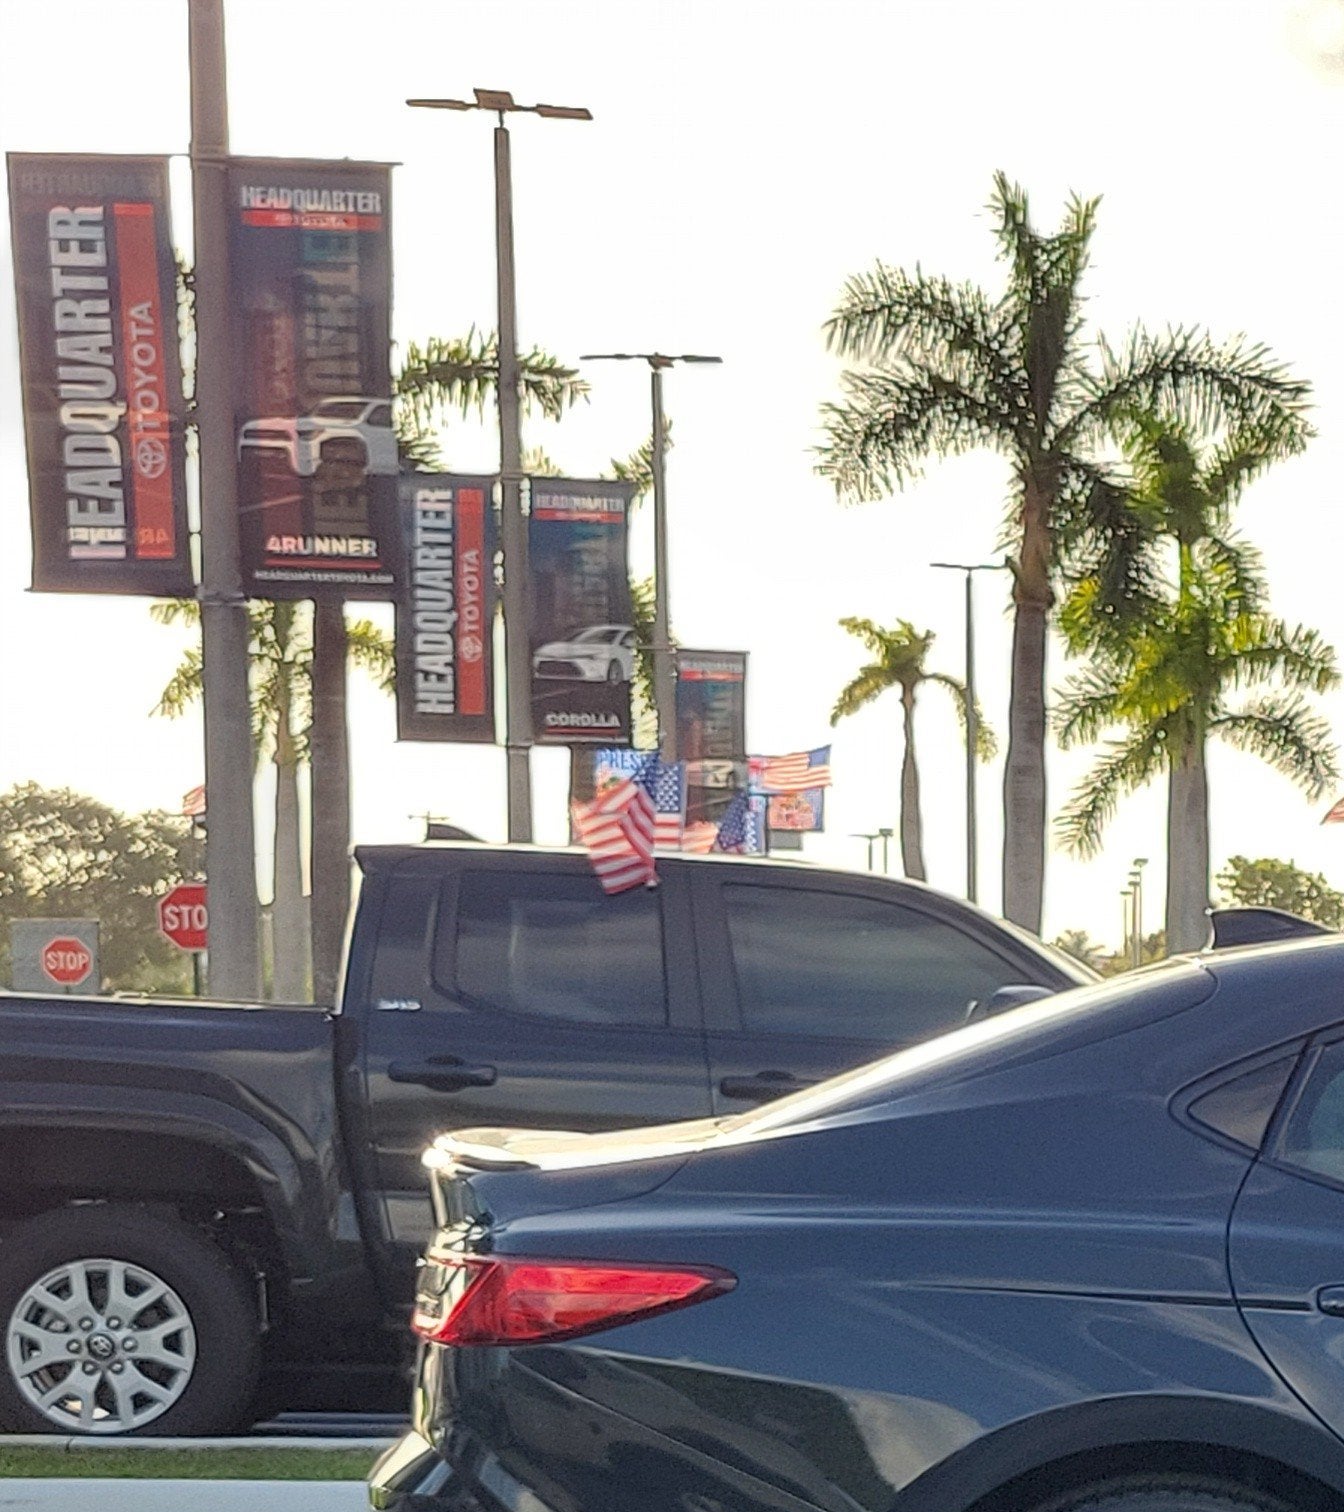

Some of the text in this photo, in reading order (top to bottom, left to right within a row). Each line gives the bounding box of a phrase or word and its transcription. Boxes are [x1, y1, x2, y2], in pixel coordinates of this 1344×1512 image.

[241, 186, 382, 213] HEADQUARTER
[128, 300, 161, 434] TOYOTA
[48, 205, 128, 560] HEADQUARTER
[266, 535, 378, 558] 4RUNNER
[414, 487, 458, 714] HEADQUARTER
[462, 550, 480, 632] TOYOTA
[545, 712, 621, 727] COROLLA
[164, 904, 208, 932] STO
[46, 951, 89, 971] STOP
